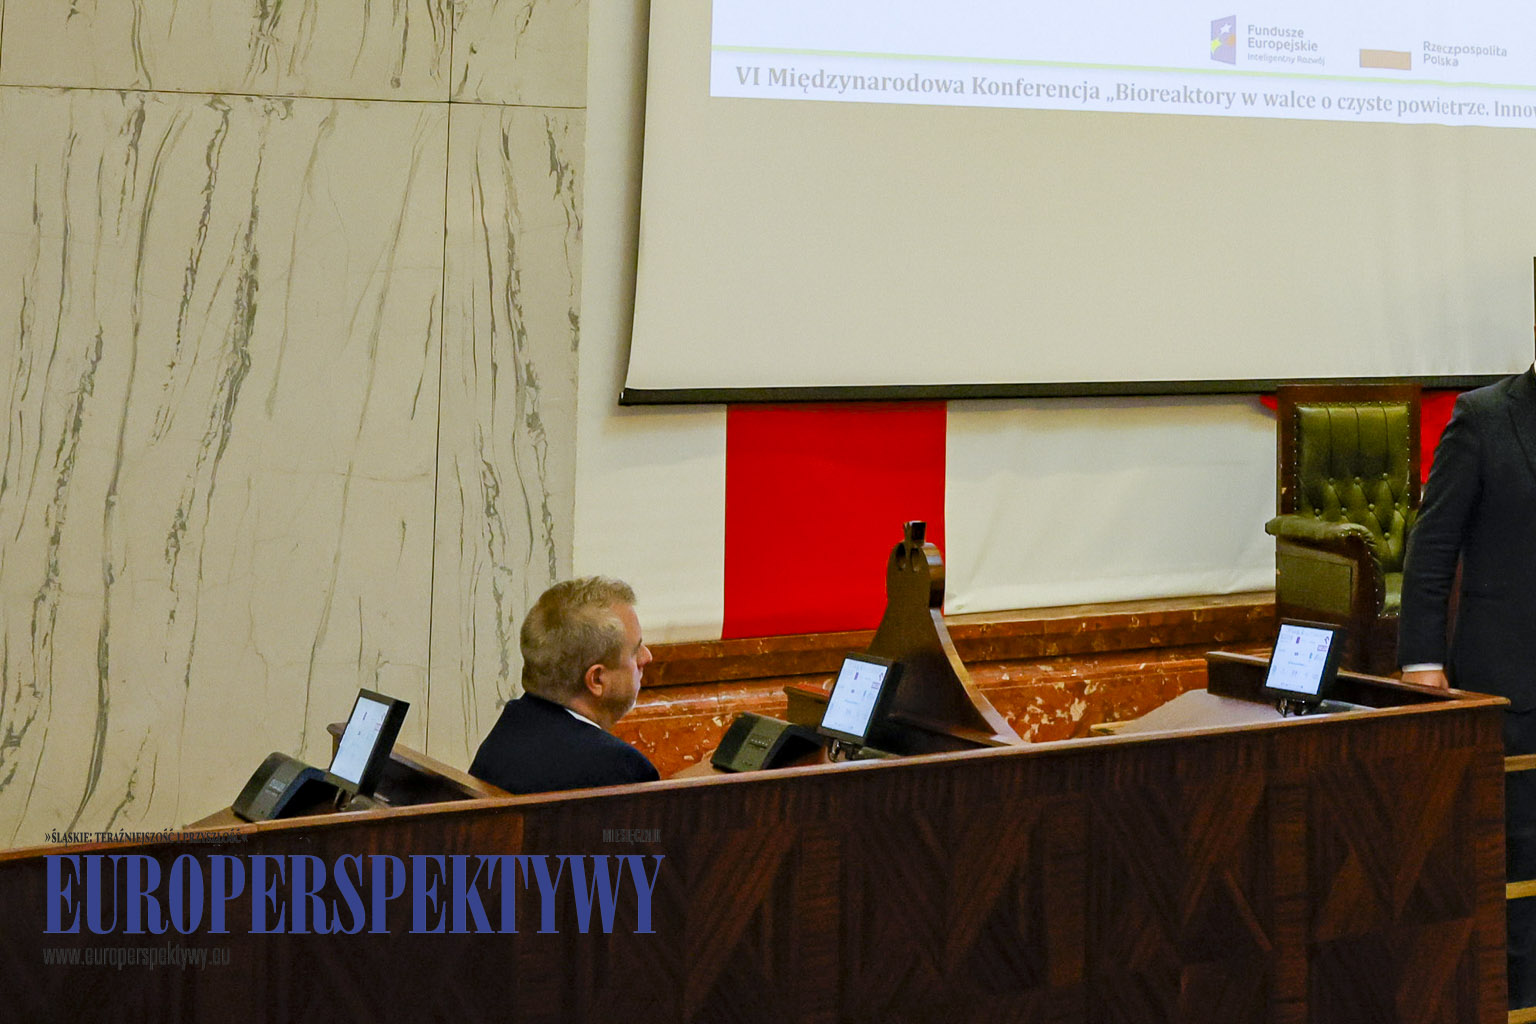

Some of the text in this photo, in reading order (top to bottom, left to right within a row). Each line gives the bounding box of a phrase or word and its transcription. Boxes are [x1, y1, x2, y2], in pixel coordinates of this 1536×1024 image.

[1247, 23, 1304, 39] Fundusze
[1247, 37, 1318, 53] Europejskie
[1423, 40, 1508, 58] Rzeczpospolita
[1423, 53, 1459, 68] Polska
[736, 65, 761, 86] VI
[767, 66, 966, 95] Międzynarodowa
[971, 77, 1100, 103] Konferencja
[1105, 81, 1236, 110] „Bioreaktory
[1240, 90, 1258, 107] w
[1262, 89, 1317, 109] walce
[1321, 95, 1332, 110] o
[1337, 94, 1393, 114] czyste
[1397, 97, 1490, 118] powietrze.
